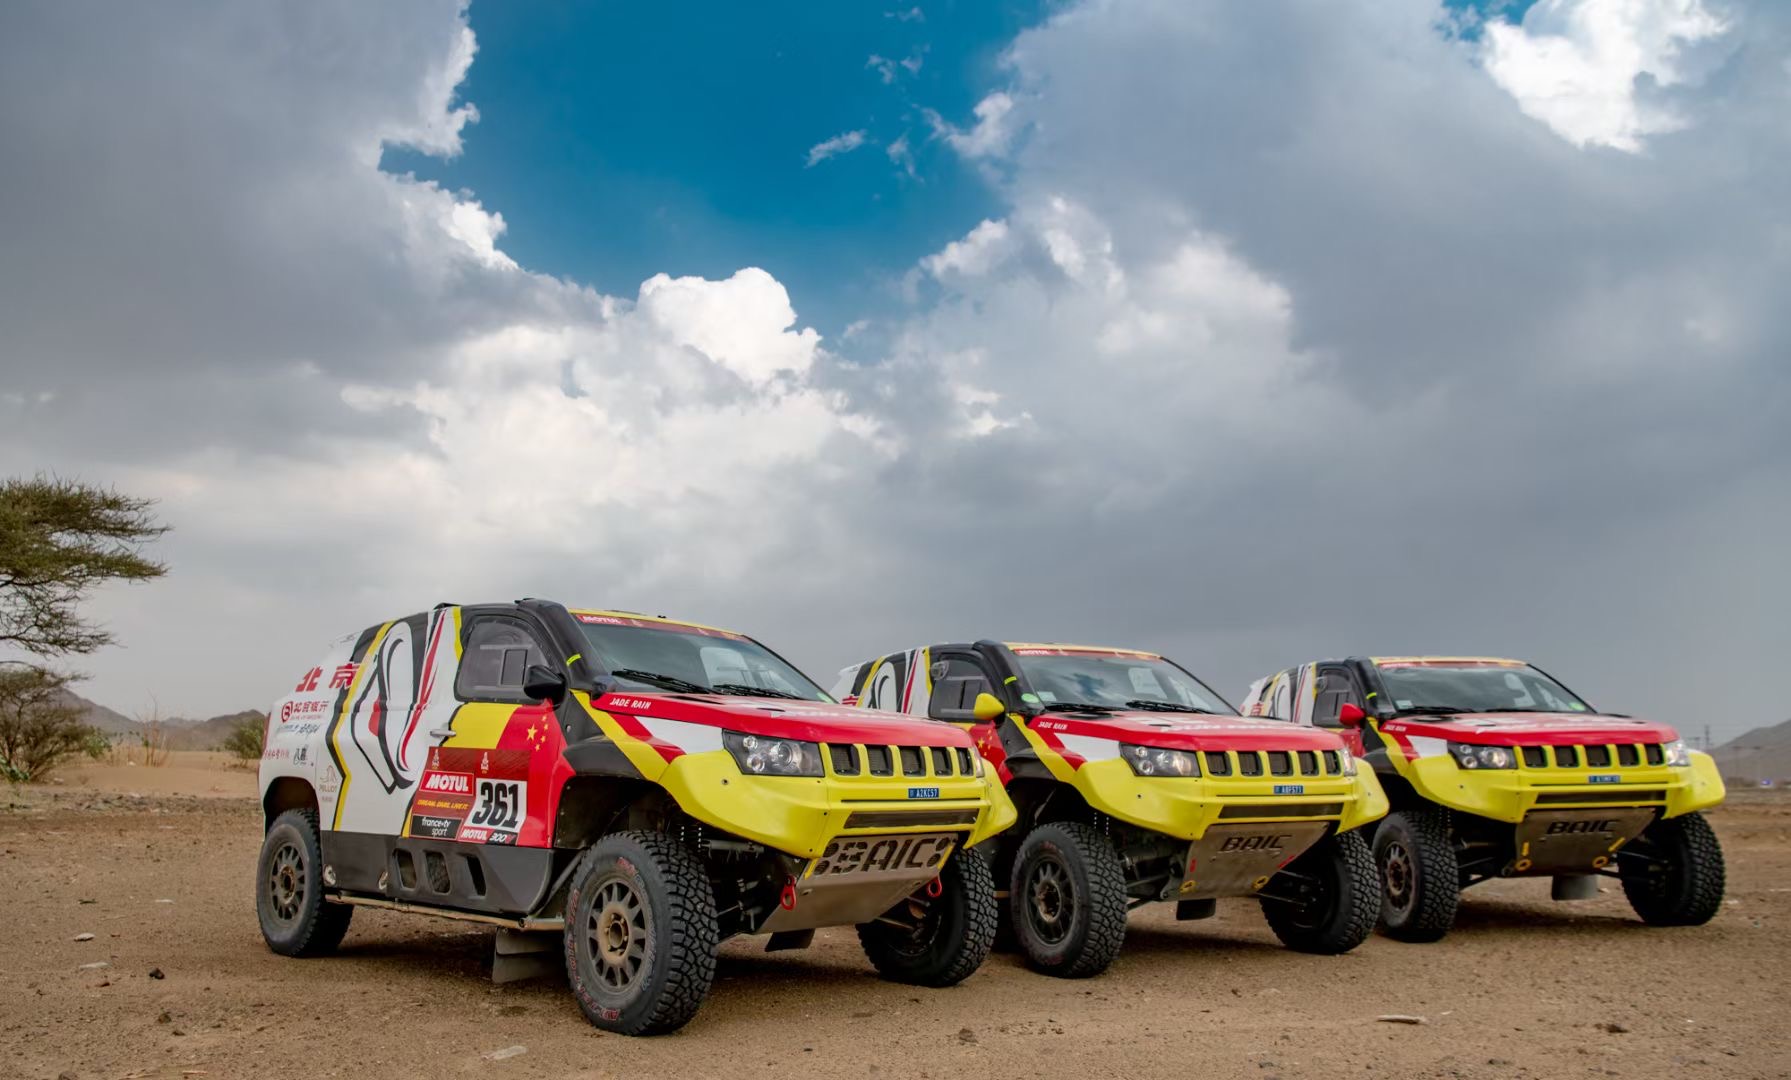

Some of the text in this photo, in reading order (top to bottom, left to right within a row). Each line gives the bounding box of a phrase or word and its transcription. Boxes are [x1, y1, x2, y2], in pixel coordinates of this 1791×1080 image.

[295, 663, 360, 691] 北京
[610, 698, 652, 709] JADE RAIN
[425, 774, 469, 792] MOTUL
[472, 782, 519, 828] 361
[431, 828, 447, 838] sport
[1547, 819, 1621, 835] BAIC
[461, 829, 487, 841] MOTUL
[489, 833, 517, 844] 300V
[1221, 835, 1293, 850] BAIC
[830, 838, 937, 874] BAIC
